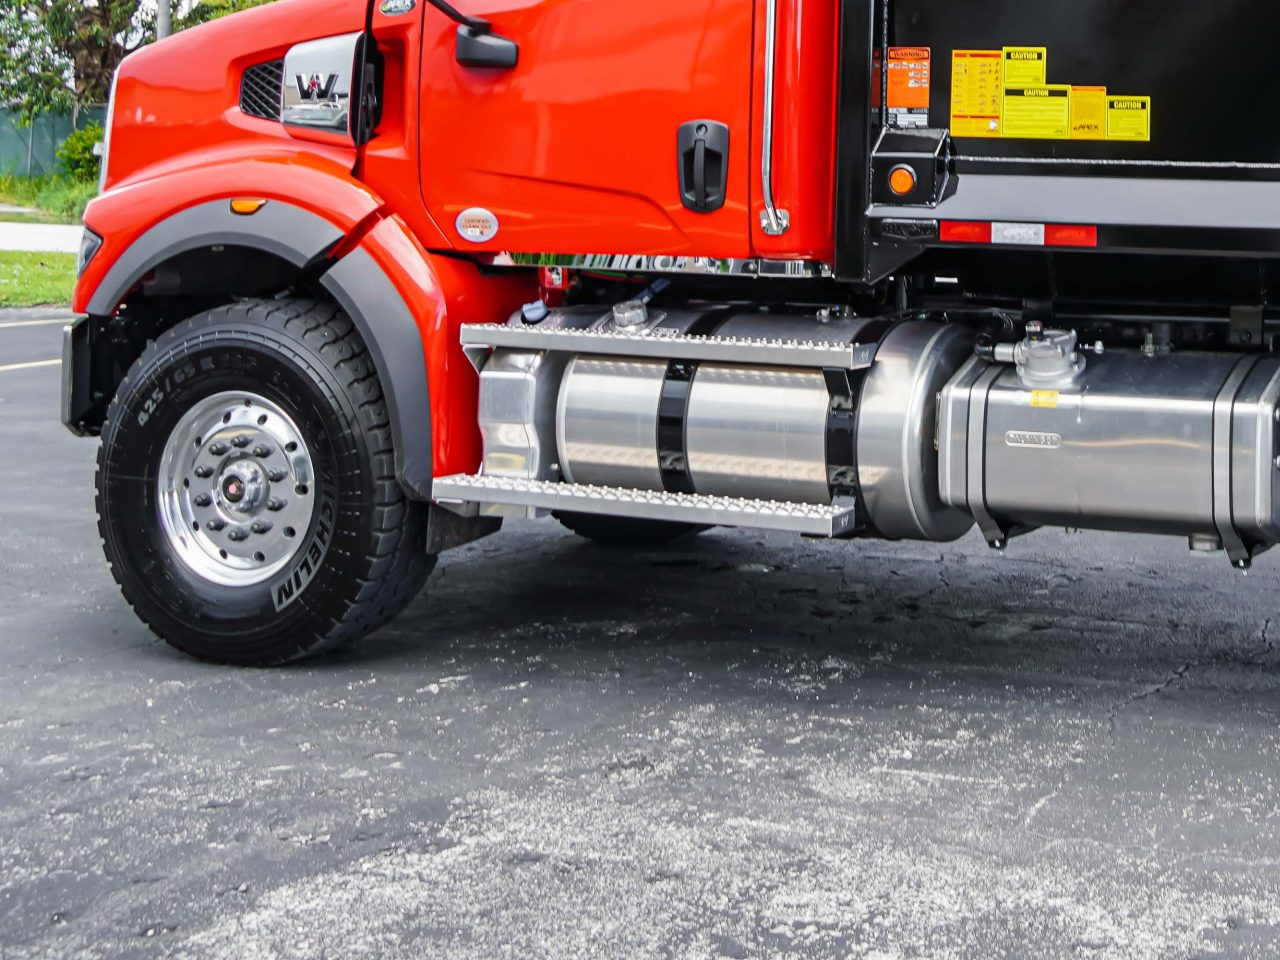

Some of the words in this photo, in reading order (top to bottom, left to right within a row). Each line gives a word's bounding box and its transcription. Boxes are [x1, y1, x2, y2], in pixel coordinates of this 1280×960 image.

[1011, 52, 1038, 60] CAUTION
[1024, 89, 1049, 97] CAUTION
[1114, 101, 1142, 109] CAUTION
[277, 458, 336, 606] MICHELIN
